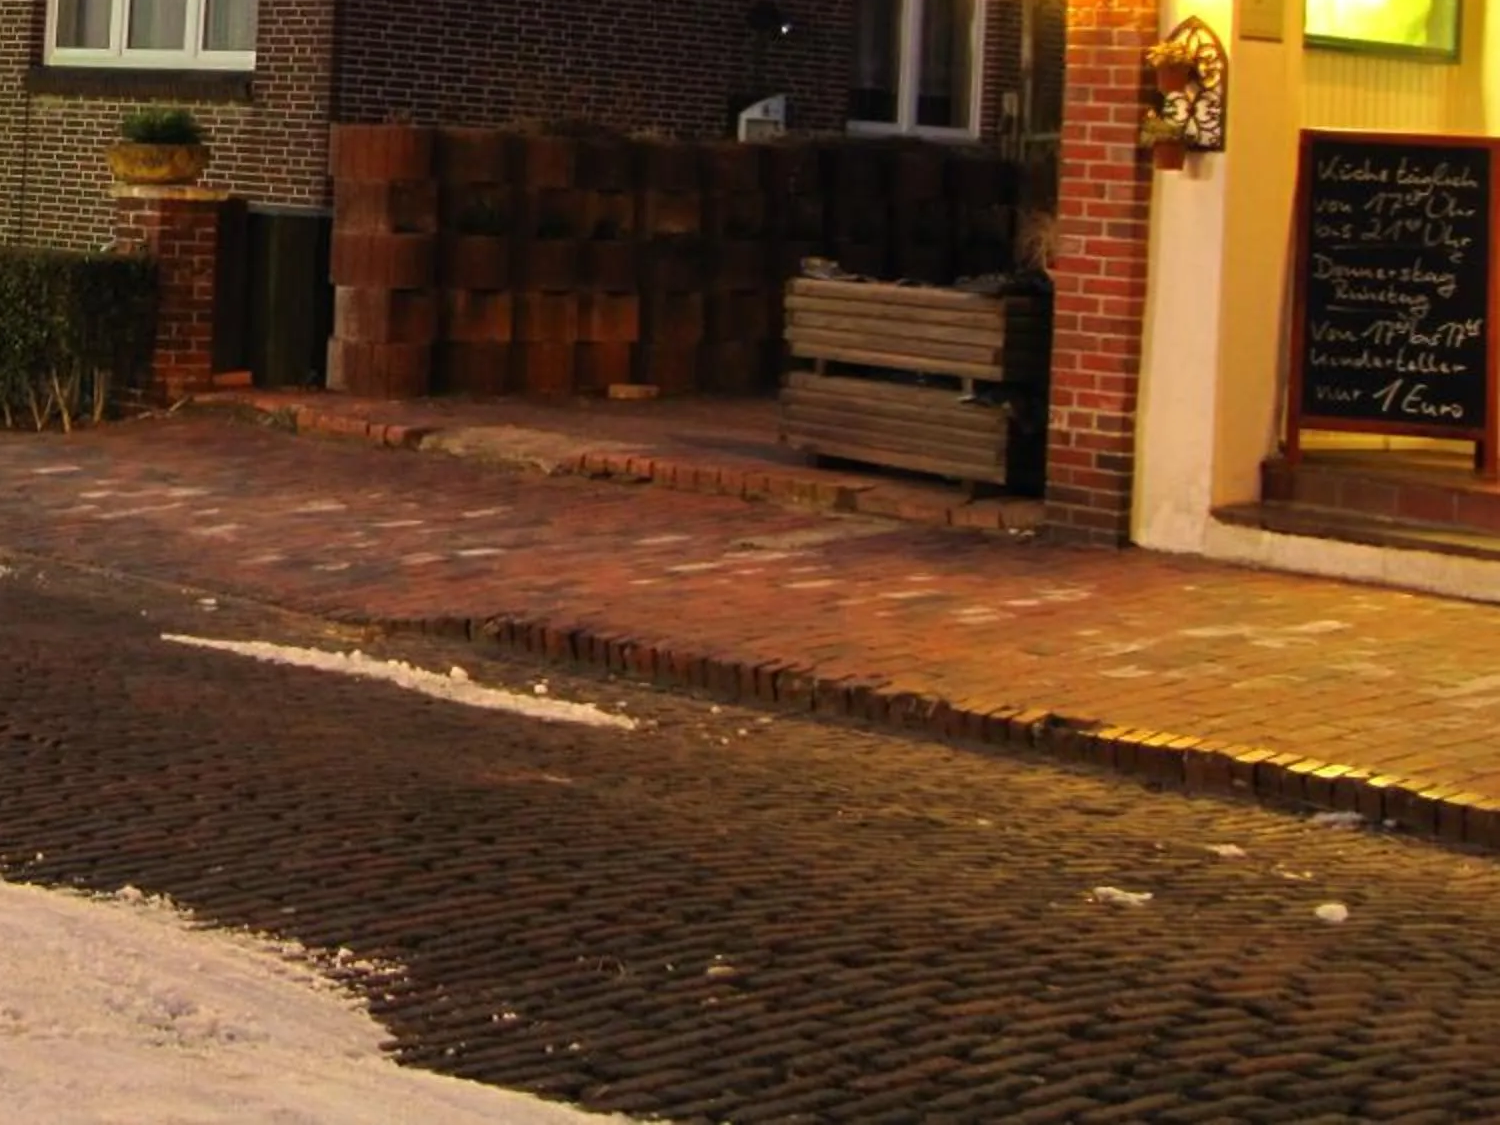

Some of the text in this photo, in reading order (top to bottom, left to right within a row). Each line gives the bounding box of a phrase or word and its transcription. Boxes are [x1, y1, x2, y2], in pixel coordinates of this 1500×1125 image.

[1315, 200, 1352, 213] von
[1425, 191, 1477, 218] Uhr
[1424, 221, 1473, 247] Uhr
[1312, 253, 1457, 299] Donnerstag
[1373, 379, 1404, 412] 1
[1401, 384, 1465, 418] Euro
